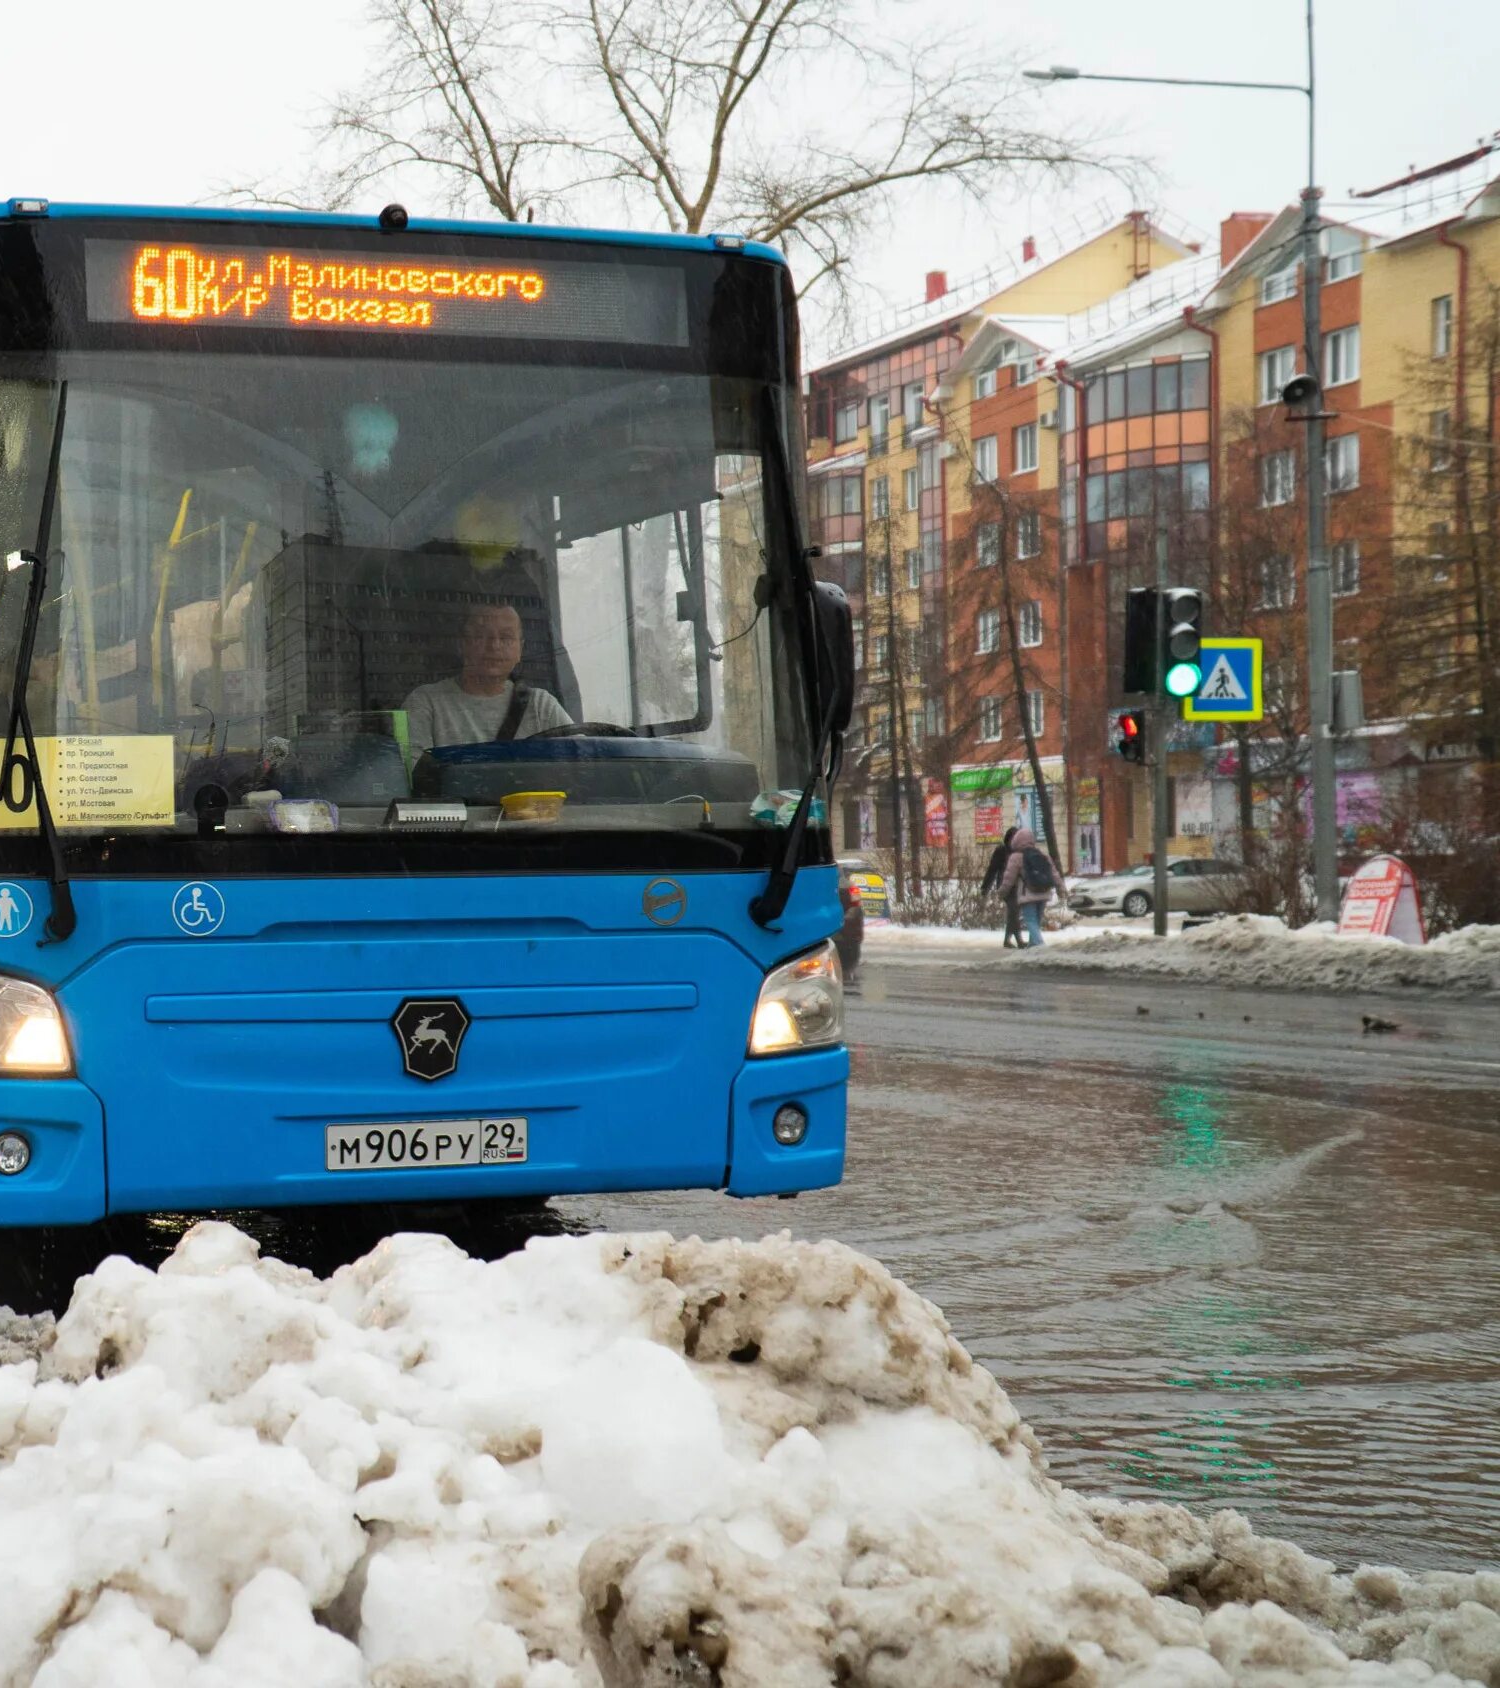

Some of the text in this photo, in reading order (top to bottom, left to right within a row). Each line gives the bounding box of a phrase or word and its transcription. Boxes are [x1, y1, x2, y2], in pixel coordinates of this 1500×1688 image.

[134, 247, 196, 320] 60
[291, 289, 433, 325] Вокзал
[79, 749, 115, 758] Троицкий
[80, 762, 129, 770] Предмостная
[80, 787, 134, 795] Усть-Двинская
[80, 812, 133, 820] Малиновского
[484, 1122, 516, 1149] 29
[483, 1148, 506, 1160] RUS
